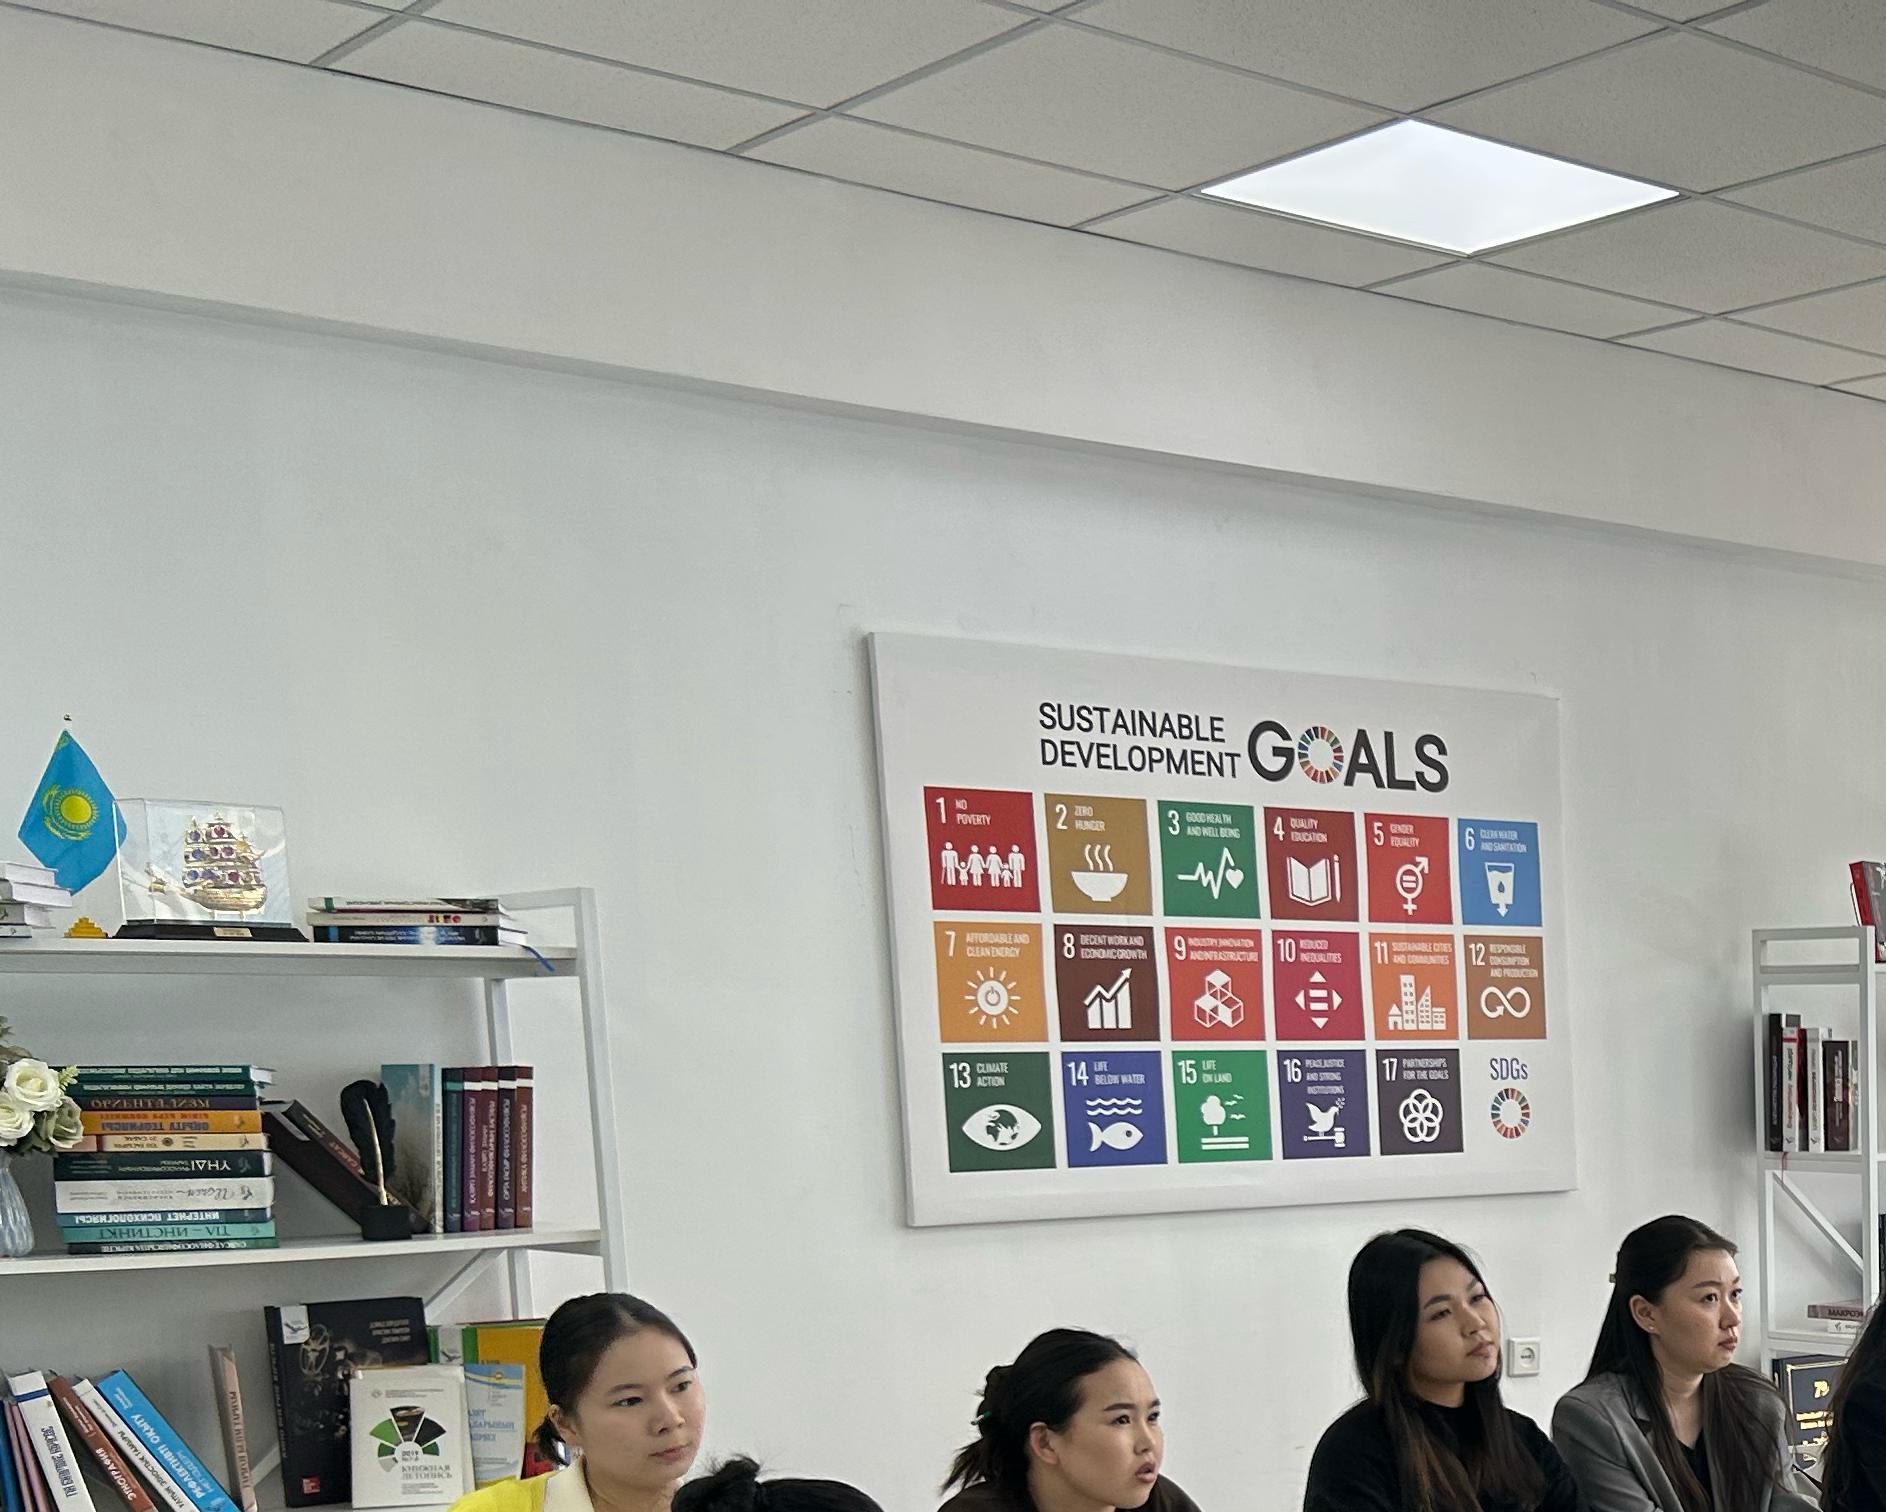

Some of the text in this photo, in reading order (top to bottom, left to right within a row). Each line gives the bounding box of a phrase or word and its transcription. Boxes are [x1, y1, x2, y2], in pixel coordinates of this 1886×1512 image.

[1039, 702, 1226, 743] SUSTAINABLE
[1040, 738, 1241, 778] DEVELOPMENT
[1247, 720, 1449, 793] GOALS
[936, 797, 947, 824] 1
[955, 799, 967, 811] NO
[1074, 805, 1094, 817] ZERO
[956, 813, 992, 826] POVERTY
[1055, 803, 1068, 830] 2
[1167, 810, 1180, 836] 3
[1185, 811, 1232, 825] GOOD HEALTH
[1074, 819, 1106, 832] HUNGER
[1273, 816, 1285, 842] 4
[1289, 817, 1319, 830] QUALITY
[1389, 823, 1414, 834] GENDER
[1186, 826, 1202, 837] AND
[1290, 831, 1328, 843] EDUCATION
[1373, 821, 1385, 846] 5
[1479, 829, 1519, 841] CLEAN WATER
[1390, 837, 1420, 848] EQUALITY
[1464, 827, 1475, 851] 6
[1480, 841, 1528, 853] AND SANITATION
[945, 931, 956, 957] 7
[966, 932, 1030, 945] AFFORDABLE AND
[1080, 934, 1144, 946] DECENT WORK AND
[1300, 939, 1329, 950] REDUCED
[966, 946, 1020, 958] CLEAN ENERGY
[1063, 932, 1075, 959] 8
[1173, 935, 1186, 960] 9
[1277, 937, 1296, 962] 10
[1391, 942, 1452, 953] SUSTAINABLE CITIES
[1489, 944, 1526, 954] RESPONSIBLE
[1080, 948, 1148, 960] ECONOMIC GROWTH
[1300, 952, 1342, 963] INEQUALITIES
[1374, 941, 1389, 964] 11
[1468, 943, 1486, 966] 12
[1393, 955, 1450, 965] AND COMMUNITIES
[1490, 956, 1530, 966] CONSUMPTION
[1490, 968, 1539, 978] AND PRODUCTION
[976, 1062, 1009, 1074] CLIMATE
[1094, 1061, 1108, 1072] LIFE
[1202, 1060, 1216, 1071] LIFE
[1382, 1058, 1399, 1081] 17
[1402, 1058, 1448, 1069] PARTNERSHIPS
[1489, 1057, 1529, 1080] SDGs
[949, 1062, 971, 1089] 13
[1067, 1061, 1089, 1087] 14
[1177, 1060, 1198, 1084] 15
[1283, 1058, 1302, 1083] 16
[1306, 1072, 1342, 1081] AND STRONG
[1403, 1070, 1449, 1080] FOR THE GOALS
[976, 1076, 1006, 1087] ACTION
[1095, 1074, 1145, 1085] BELOW WATER
[1202, 1073, 1232, 1083] ON LAND
[90, 1098, 210, 1109] ОРИЕНТАЛИЗМ
[75, 1211, 220, 1224] ИНТЕРНЕТ ПСИХОЛОГИЯСЫ
[100, 1226, 188, 1239] ИНСТИНКТ
[130, 1413, 161, 1444] ОҚЫТУ
[95, 1447, 137, 1501] ЭТНОГРАФИЯ
